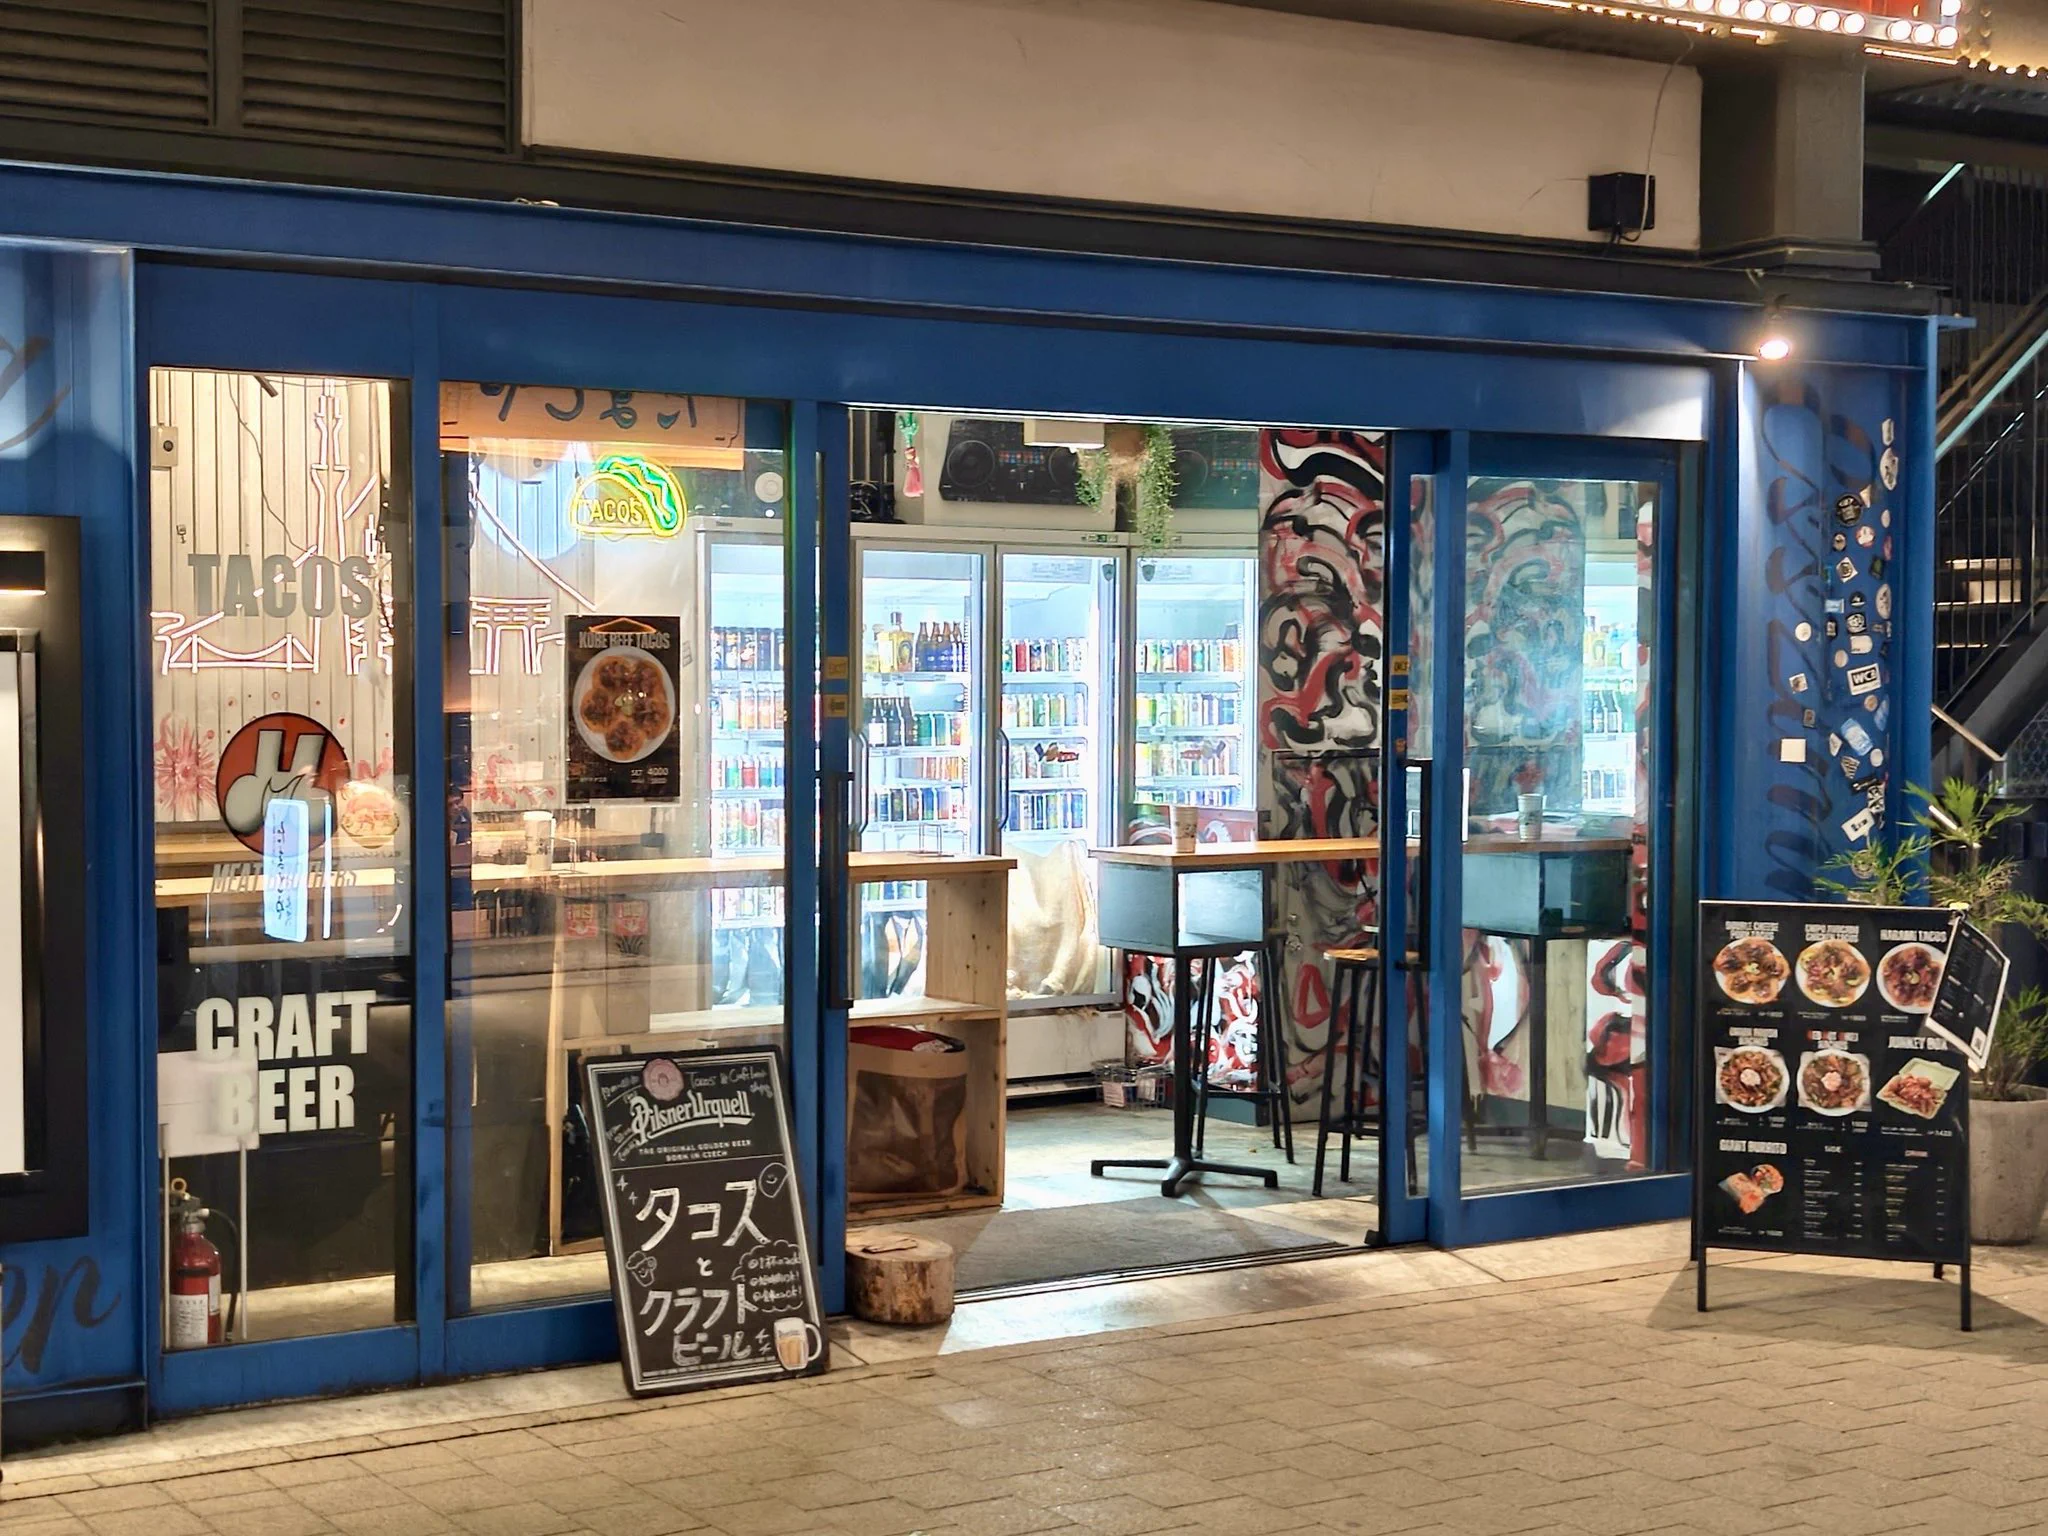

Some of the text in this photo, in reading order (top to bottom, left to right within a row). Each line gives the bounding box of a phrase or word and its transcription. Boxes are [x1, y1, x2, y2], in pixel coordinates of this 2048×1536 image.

[579, 497, 644, 525] TACOS
[188, 553, 374, 618] TACOS
[579, 632, 670, 649] KOBE BEEF TACOS
[195, 990, 377, 1062] CRAFT
[217, 1065, 355, 1136] BEER
[630, 1095, 694, 1145] Pilsner
[635, 1179, 772, 1251] タコス
[697, 1257, 713, 1277] と
[639, 1284, 758, 1337] クラフト
[672, 1331, 752, 1367] ビール
